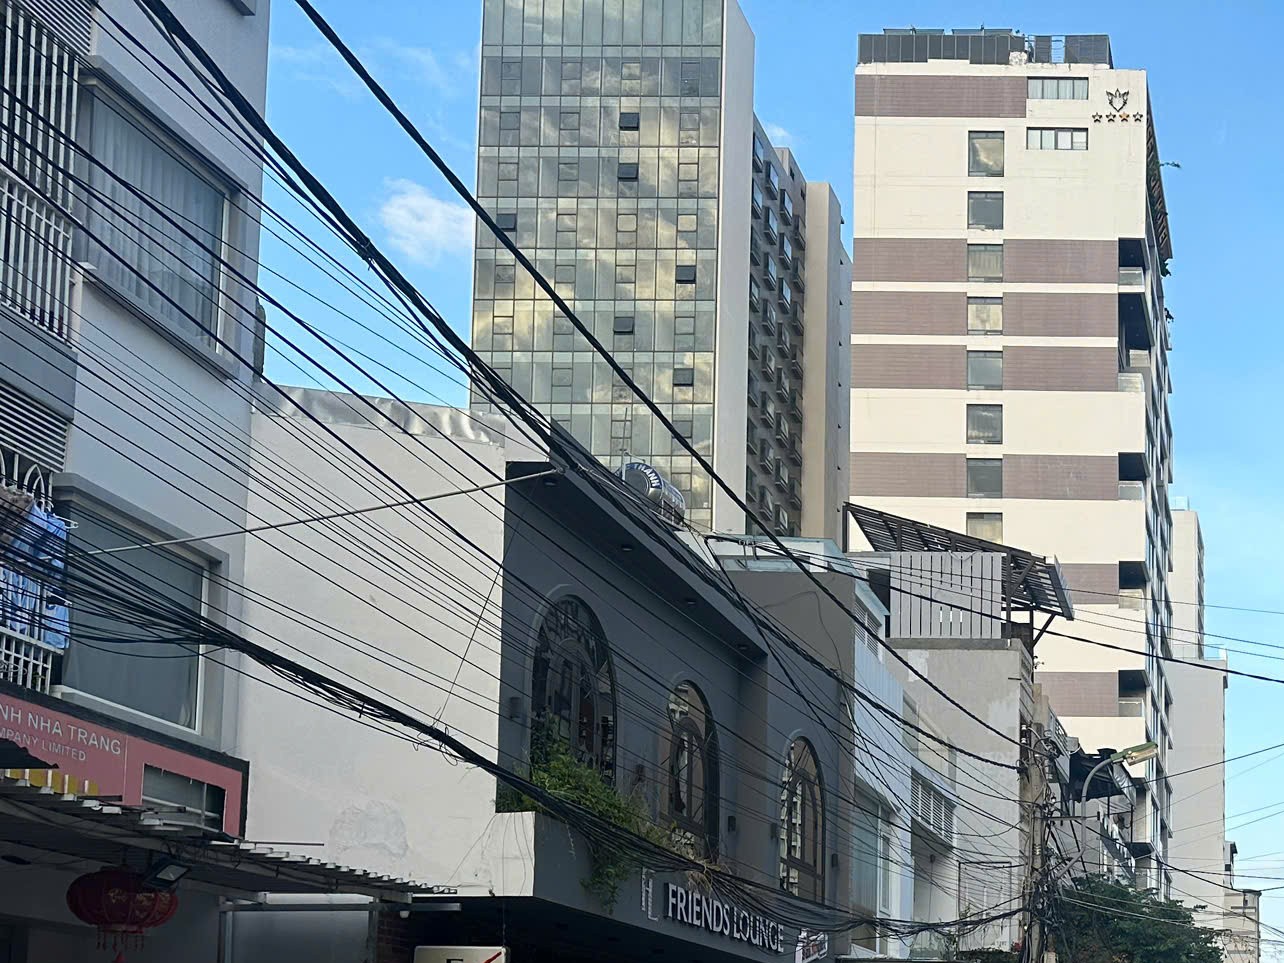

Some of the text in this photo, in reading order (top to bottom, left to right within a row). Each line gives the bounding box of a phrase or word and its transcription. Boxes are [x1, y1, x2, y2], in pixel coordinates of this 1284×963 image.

[28, 712, 63, 737] NHA
[67, 724, 121, 756] TRANG
[42, 739, 86, 761] LIMITED
[667, 882, 730, 936] FRIENDS
[734, 907, 784, 954] LOUNGE
